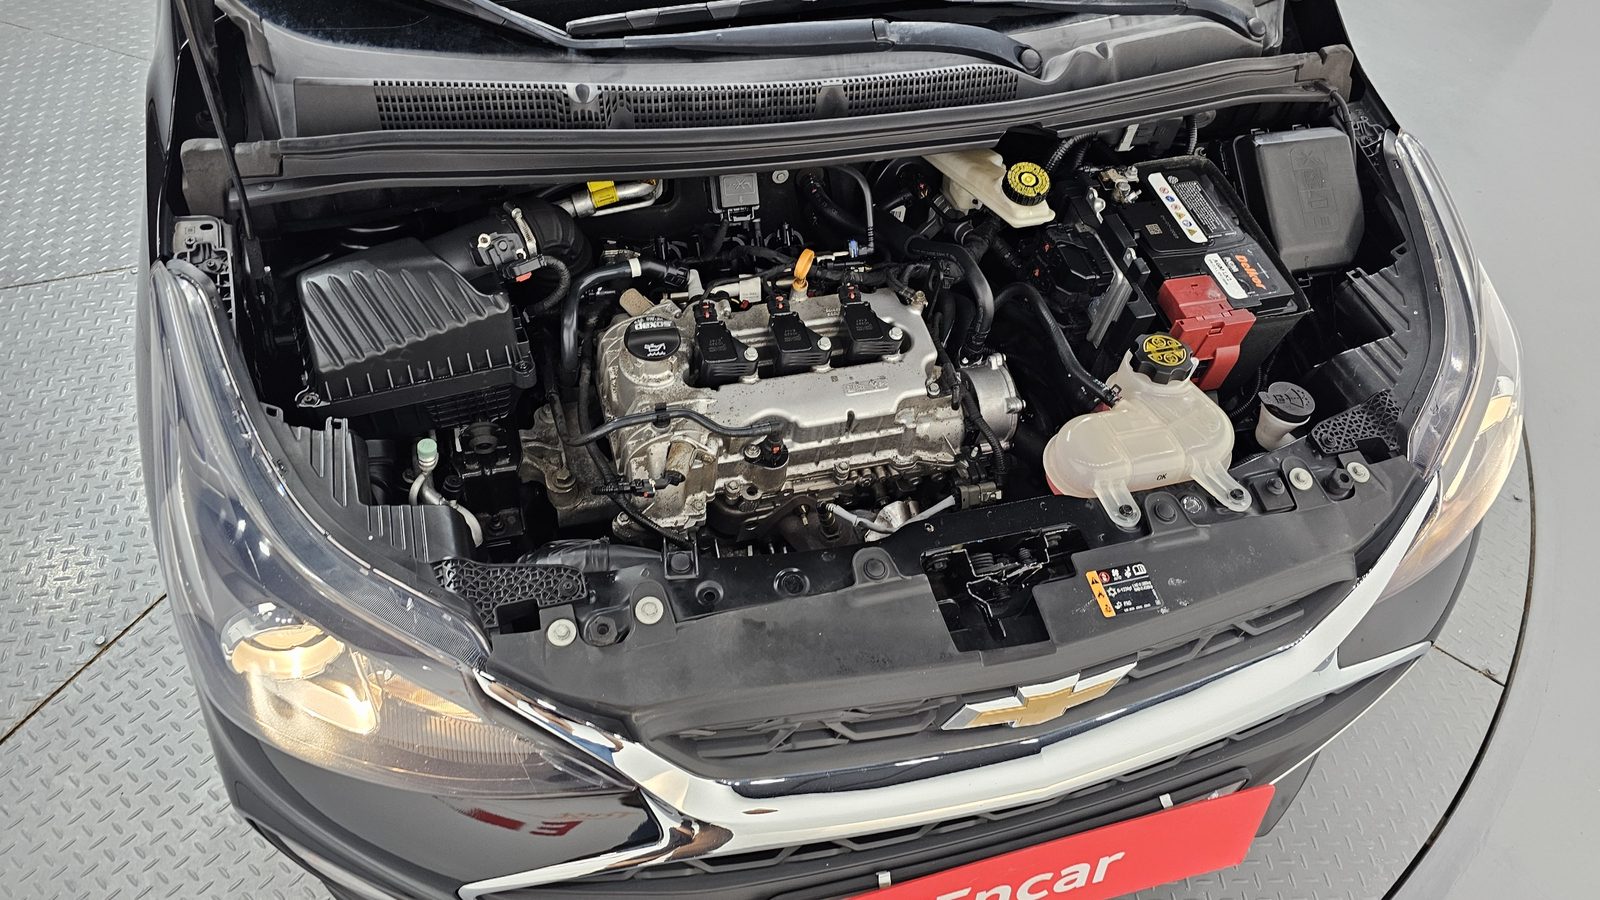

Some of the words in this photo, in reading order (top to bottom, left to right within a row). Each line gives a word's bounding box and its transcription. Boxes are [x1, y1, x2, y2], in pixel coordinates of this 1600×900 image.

[1223, 256, 1239, 273] AGM
[1235, 254, 1267, 290] Delkor
[634, 320, 673, 331] dexos
[1156, 473, 1167, 481] OK
